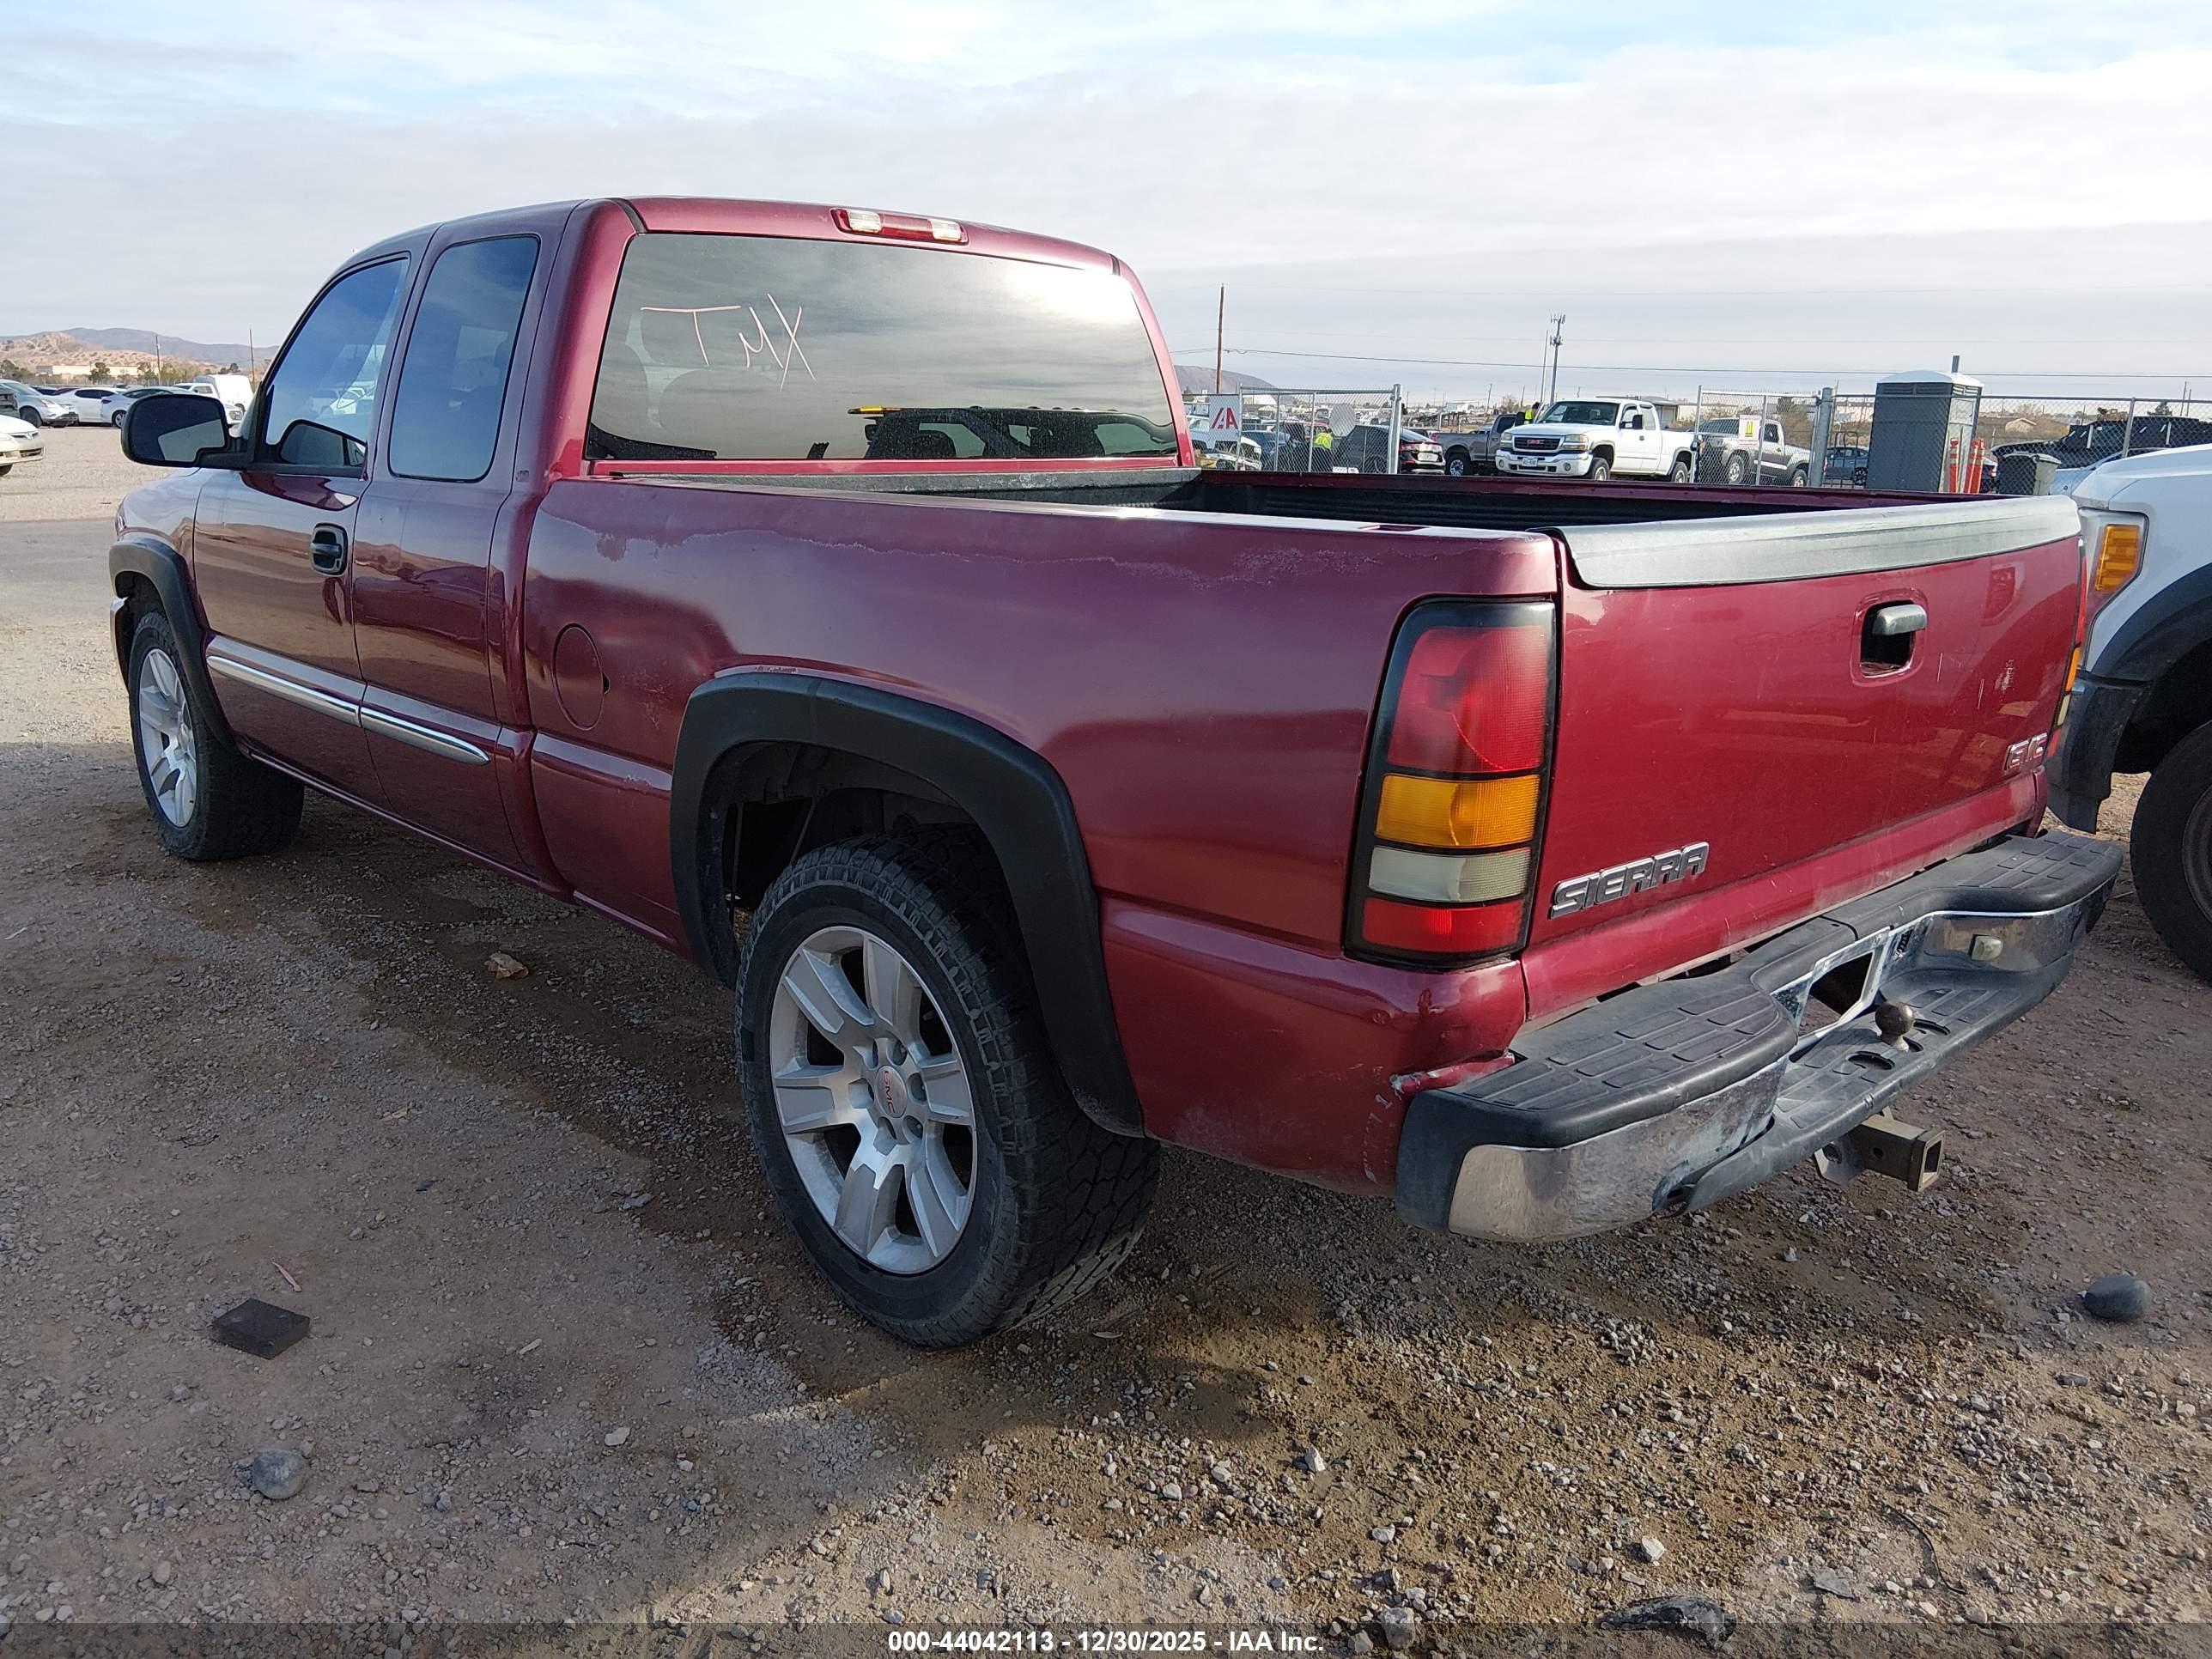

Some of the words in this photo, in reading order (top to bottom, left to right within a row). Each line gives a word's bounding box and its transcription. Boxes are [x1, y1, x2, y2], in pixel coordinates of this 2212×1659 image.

[640, 293, 817, 392] TMX
[1549, 841, 1710, 920] SIERRA
[884, 1070, 896, 1114] GMC
